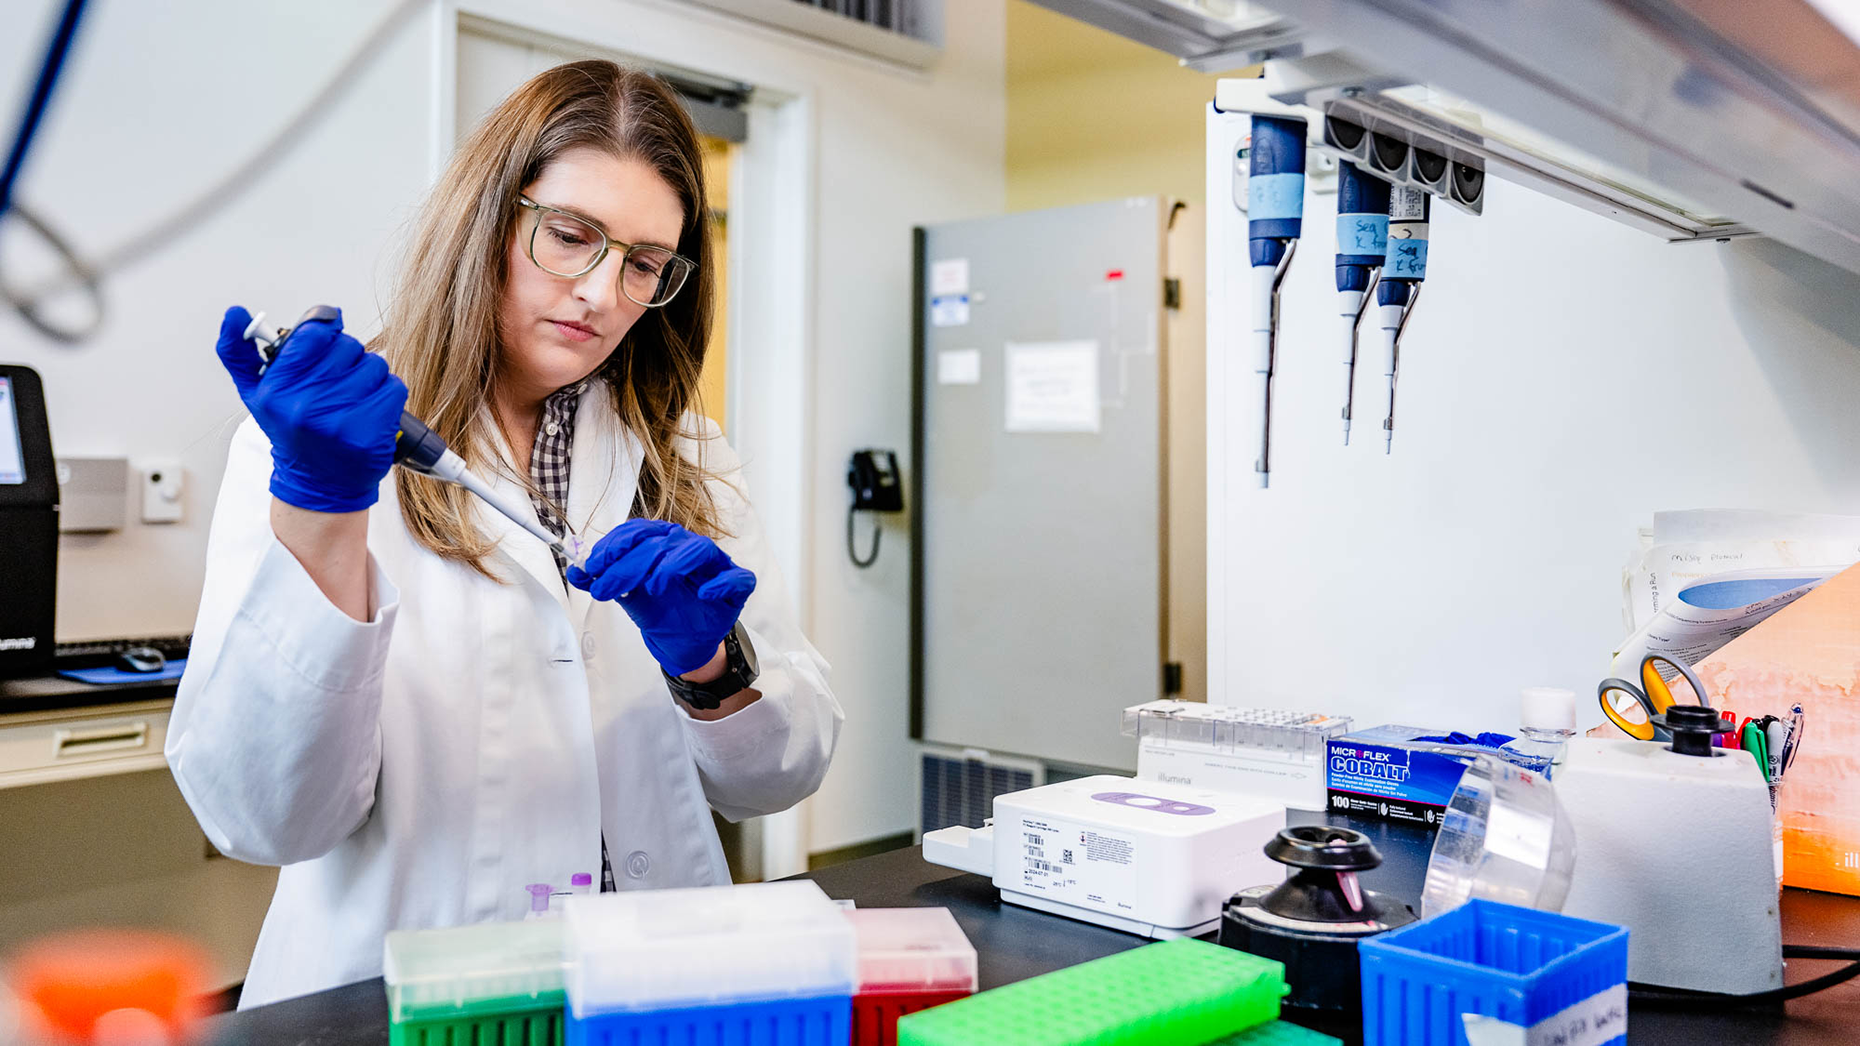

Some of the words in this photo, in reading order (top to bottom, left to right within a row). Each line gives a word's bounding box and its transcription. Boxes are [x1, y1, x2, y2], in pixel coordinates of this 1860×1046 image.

[1331, 755, 1408, 782] COBALT
[1158, 772, 1191, 785] illumina
[1332, 795, 1350, 809] 100
